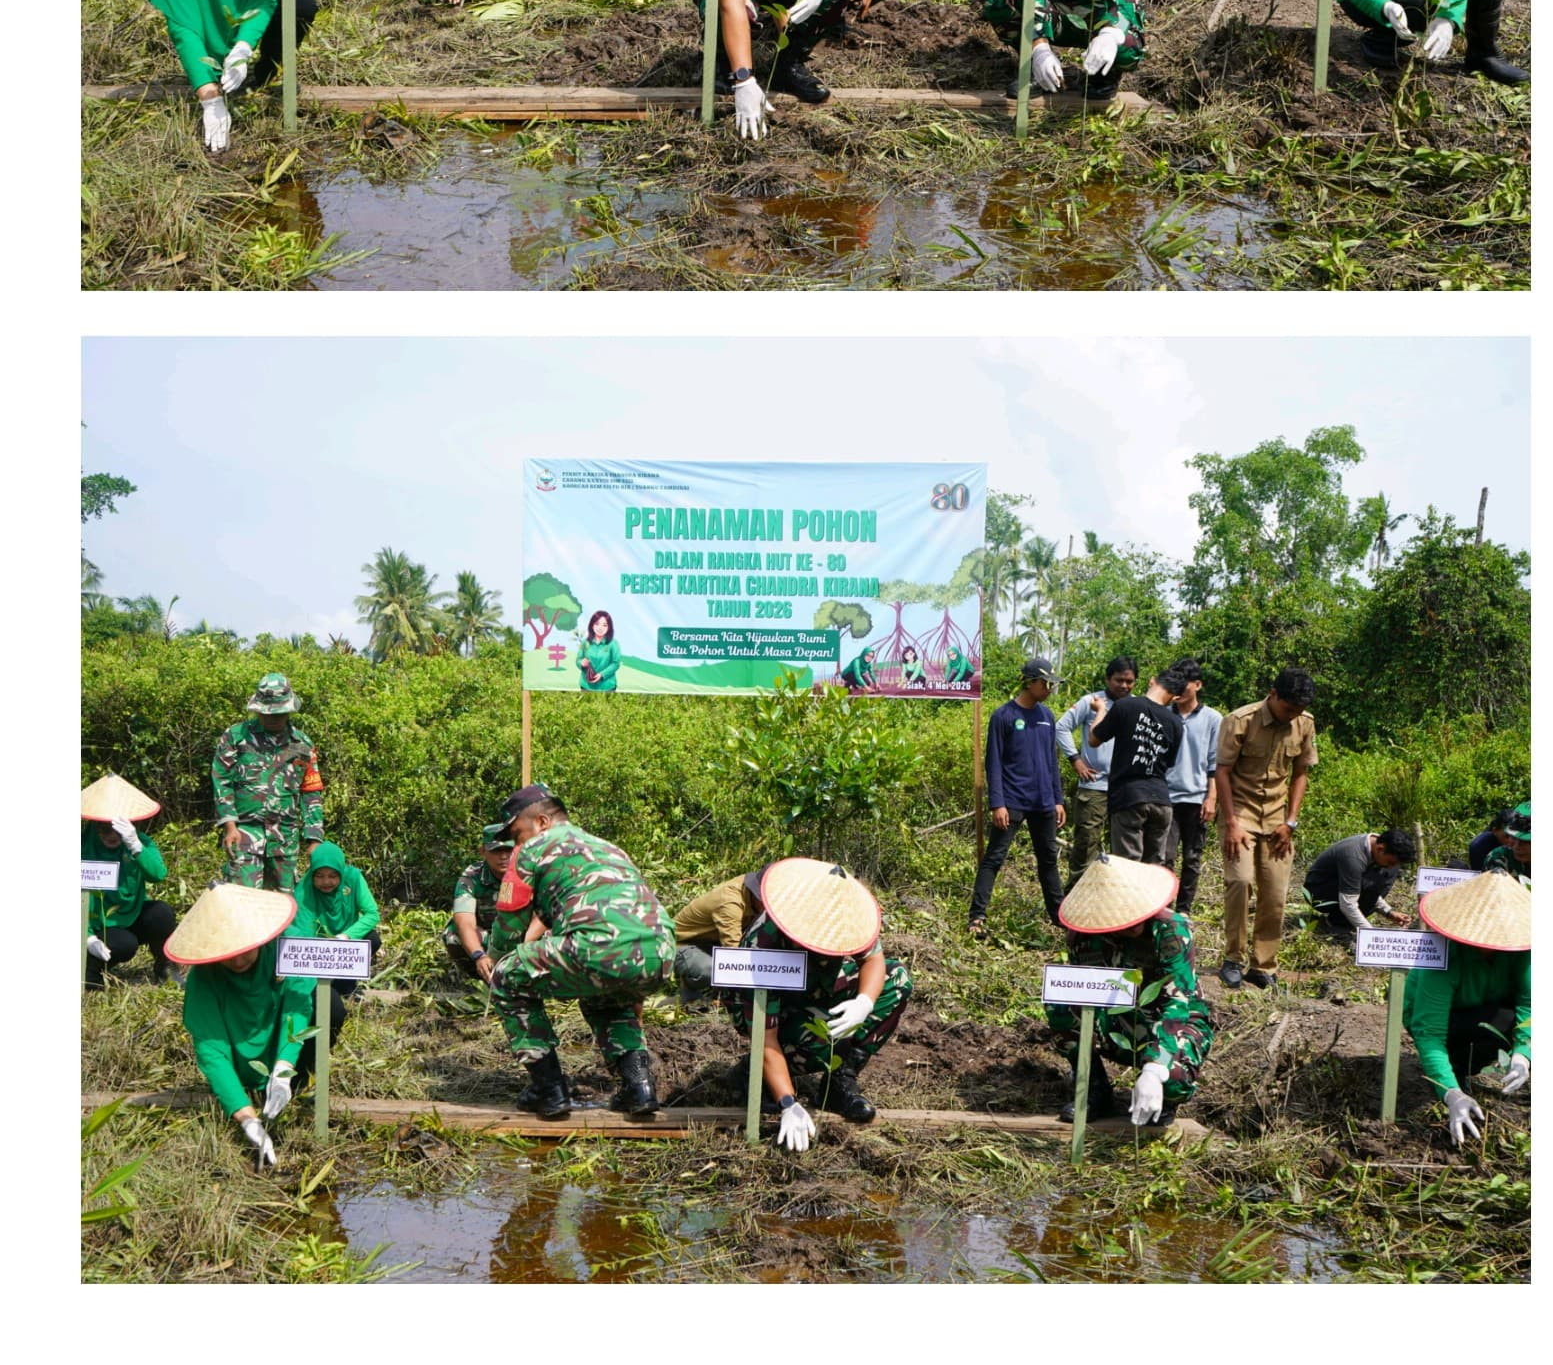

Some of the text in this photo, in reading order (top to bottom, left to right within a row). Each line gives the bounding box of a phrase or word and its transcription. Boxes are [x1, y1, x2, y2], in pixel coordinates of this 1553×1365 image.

[930, 481, 969, 512] 80
[625, 507, 877, 542] PENANAMAN POHON
[654, 551, 847, 572] DALAM RANGKA HUT KE 80
[620, 573, 880, 598] PERSIT KARTIKA CHANDRA KIRANA
[706, 599, 792, 619] TAHUN 2026
[670, 630, 827, 648] Bersama Kita Hijaukan Bumi
[662, 644, 834, 661] Satu Pohon Untuk Masa Depan!
[906, 681, 971, 690] Siak, 4 Mei 2026
[288, 945, 360, 955] IBU KETUA PERSIT
[313, 962, 354, 970] 0322/SIAK
[718, 963, 801, 974] DANDIM 0322/SIAK
[1050, 980, 1127, 990] KASDIM 0322/SI
